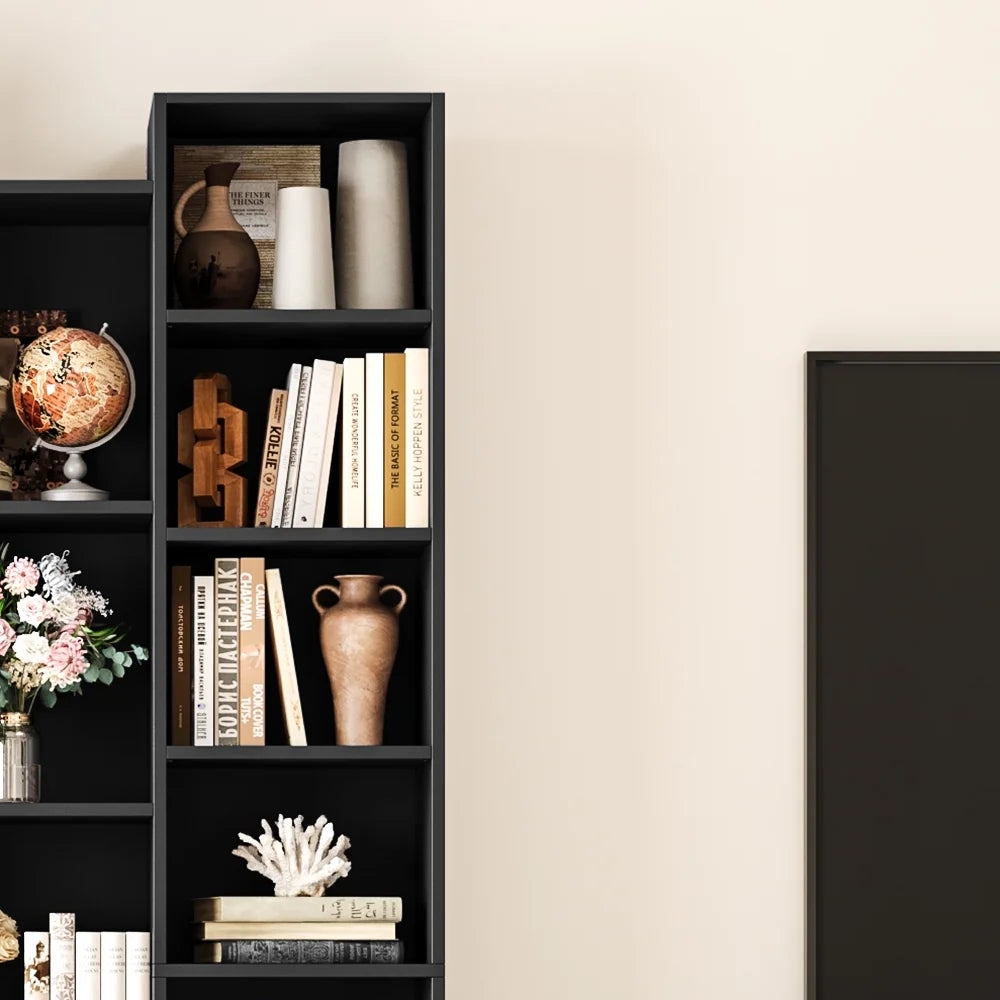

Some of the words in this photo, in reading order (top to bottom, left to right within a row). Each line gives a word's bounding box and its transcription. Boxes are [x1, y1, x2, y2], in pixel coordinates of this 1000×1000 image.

[245, 191, 271, 199] FINER
[351, 393, 359, 416] CREATE
[390, 389, 399, 427] FORMAT
[413, 389, 423, 419] STYLE
[351, 419, 359, 456] WONDERFUL
[390, 429, 399, 442] OF
[413, 422, 423, 463] HOPPEN
[390, 444, 399, 469] BASIC
[351, 458, 359, 488] HOMELIFE
[390, 472, 399, 489] THE
[413, 466, 423, 497] KELLY
[240, 572, 252, 631] CHAPMAN
[255, 584, 265, 620] CALLUM
[217, 567, 238, 673] ПАСТЕРНАК
[217, 680, 238, 738] БОРИС
[253, 683, 264, 708] BOOK
[253, 709, 264, 738] COVER
